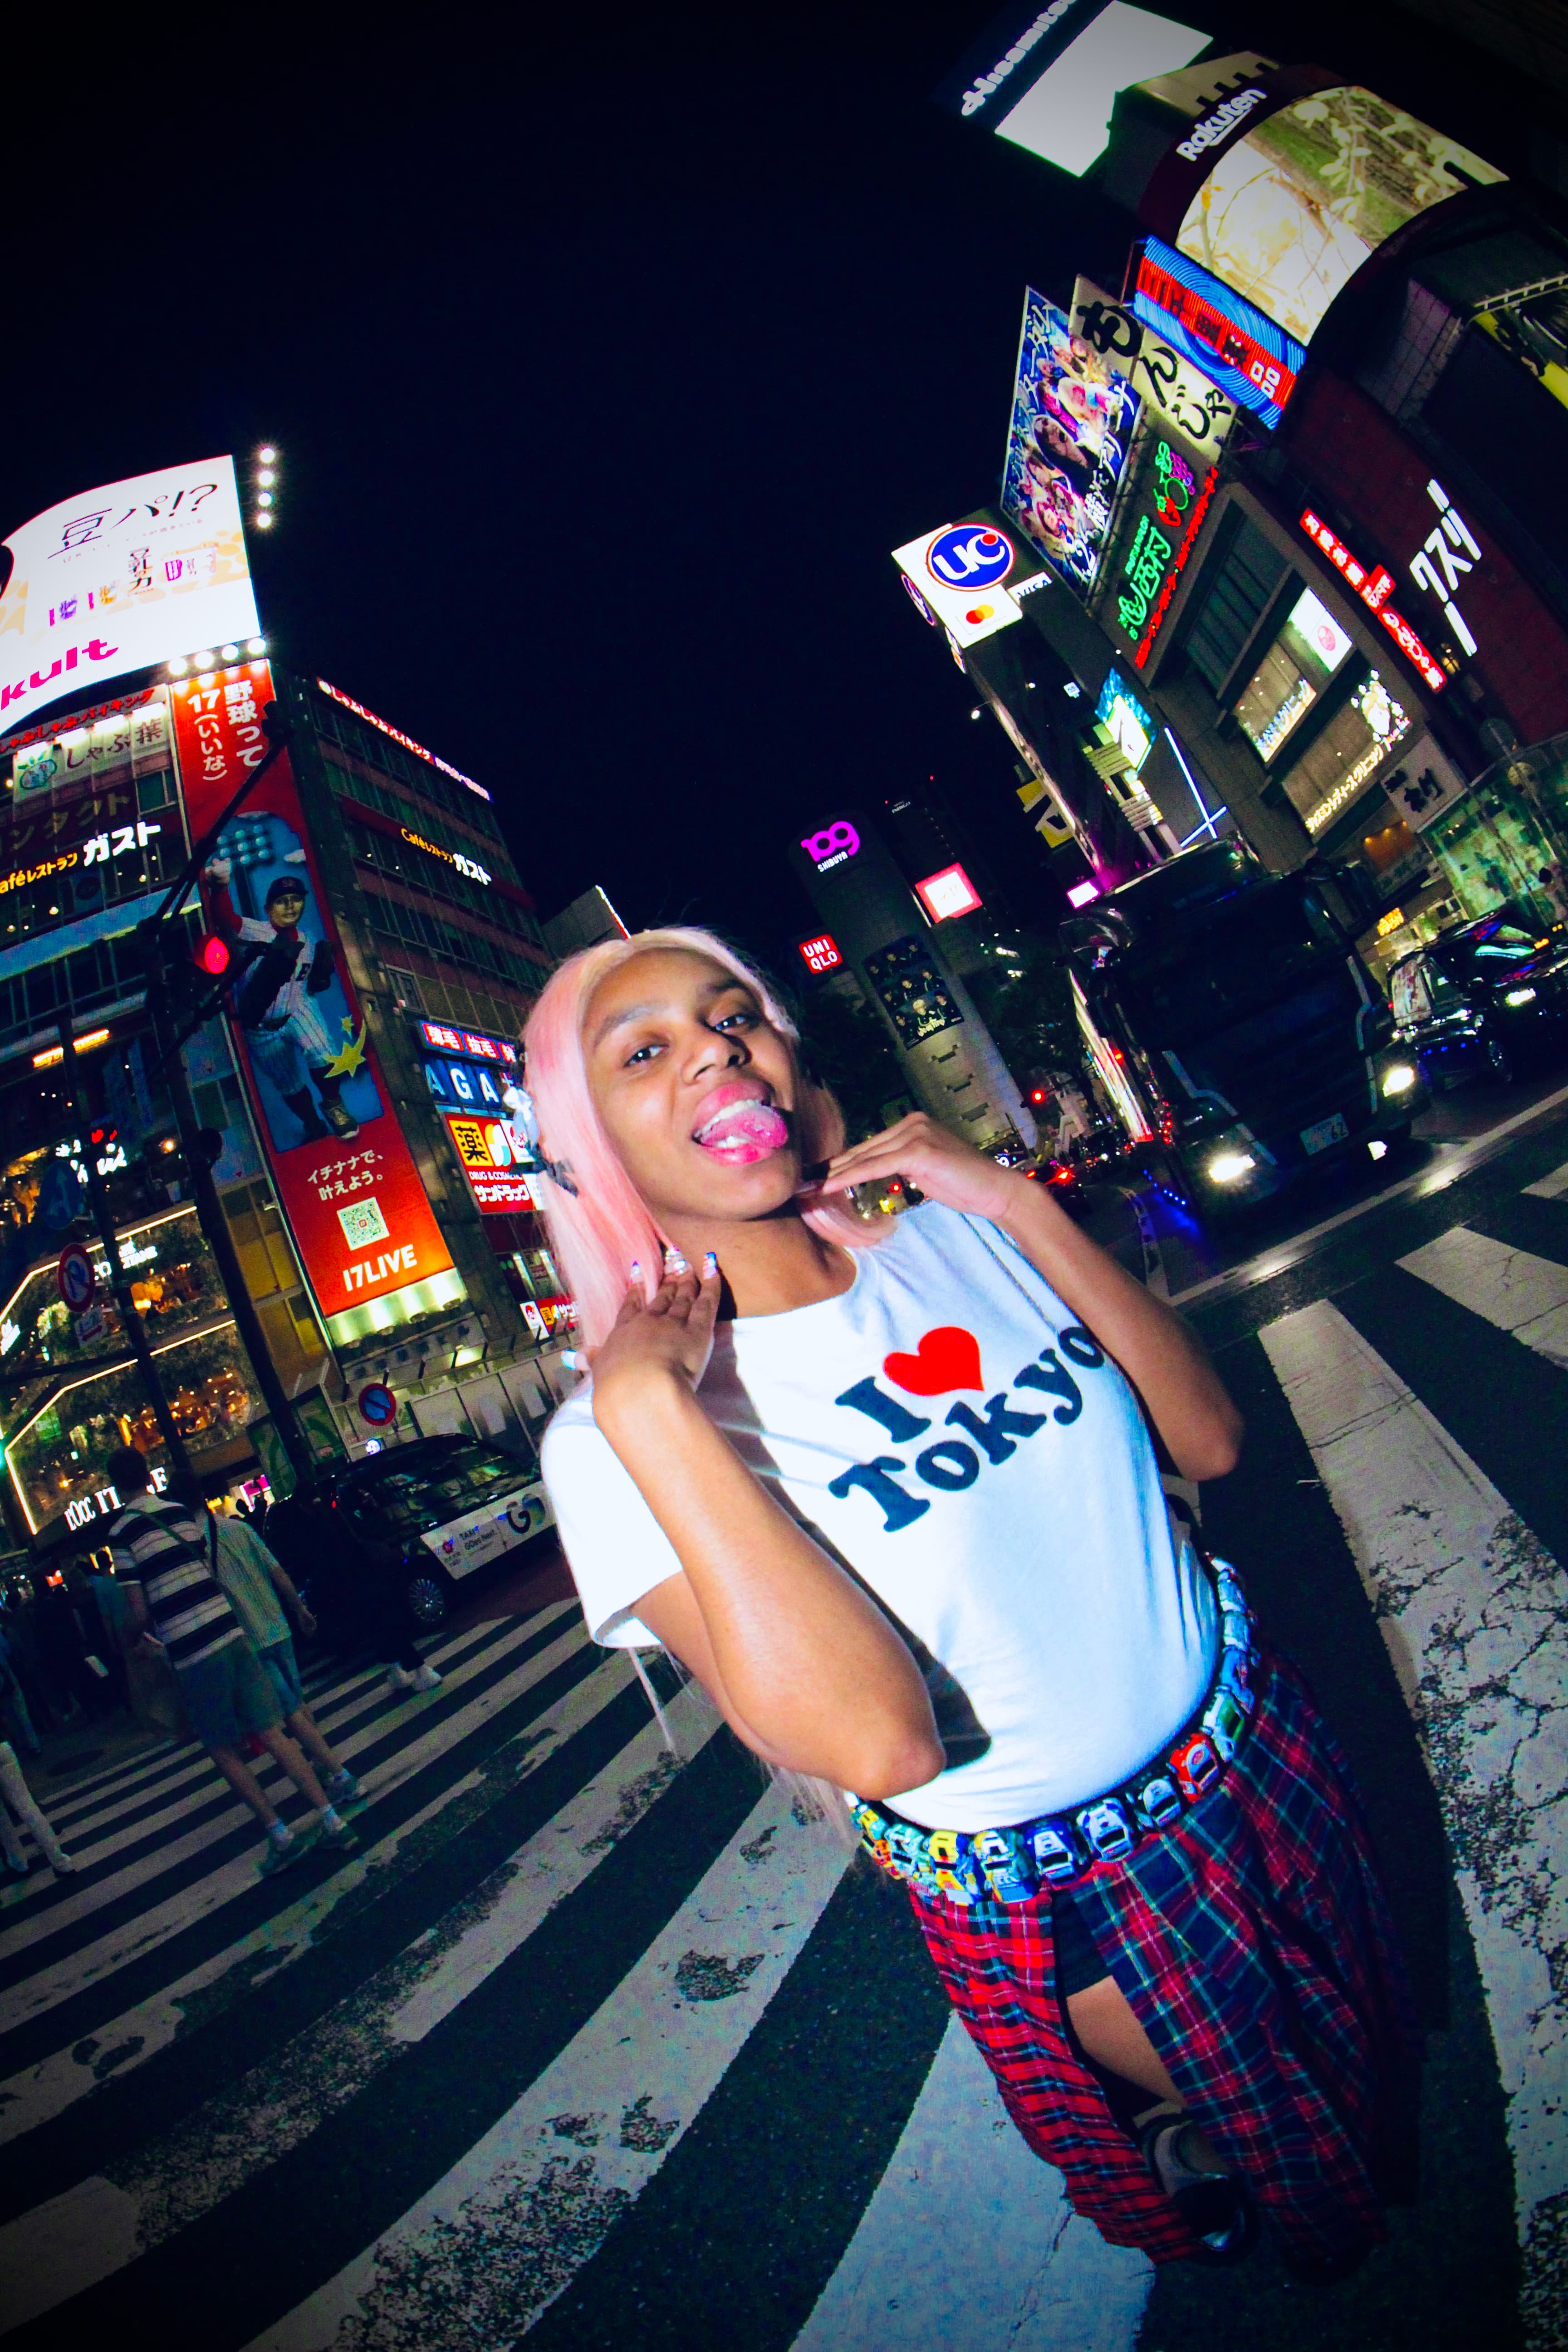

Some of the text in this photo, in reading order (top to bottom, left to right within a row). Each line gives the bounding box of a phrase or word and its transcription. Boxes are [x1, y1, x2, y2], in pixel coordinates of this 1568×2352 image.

[1176, 88, 1267, 162] Rakuten
[1078, 301, 1231, 439] もんじゃ
[1409, 508, 1481, 602] クスリ
[83, 822, 161, 867] ガスト
[801, 821, 860, 862] 109
[818, 851, 848, 872] SHIBUYA
[453, 853, 492, 885] ガスト
[803, 938, 831, 958] UNI
[810, 950, 838, 970] QLO
[425, 1064, 499, 1103] AGA
[456, 1125, 488, 1162] 薬
[828, 1326, 1105, 1532] Tokyo
[834, 1376, 932, 1444] I
